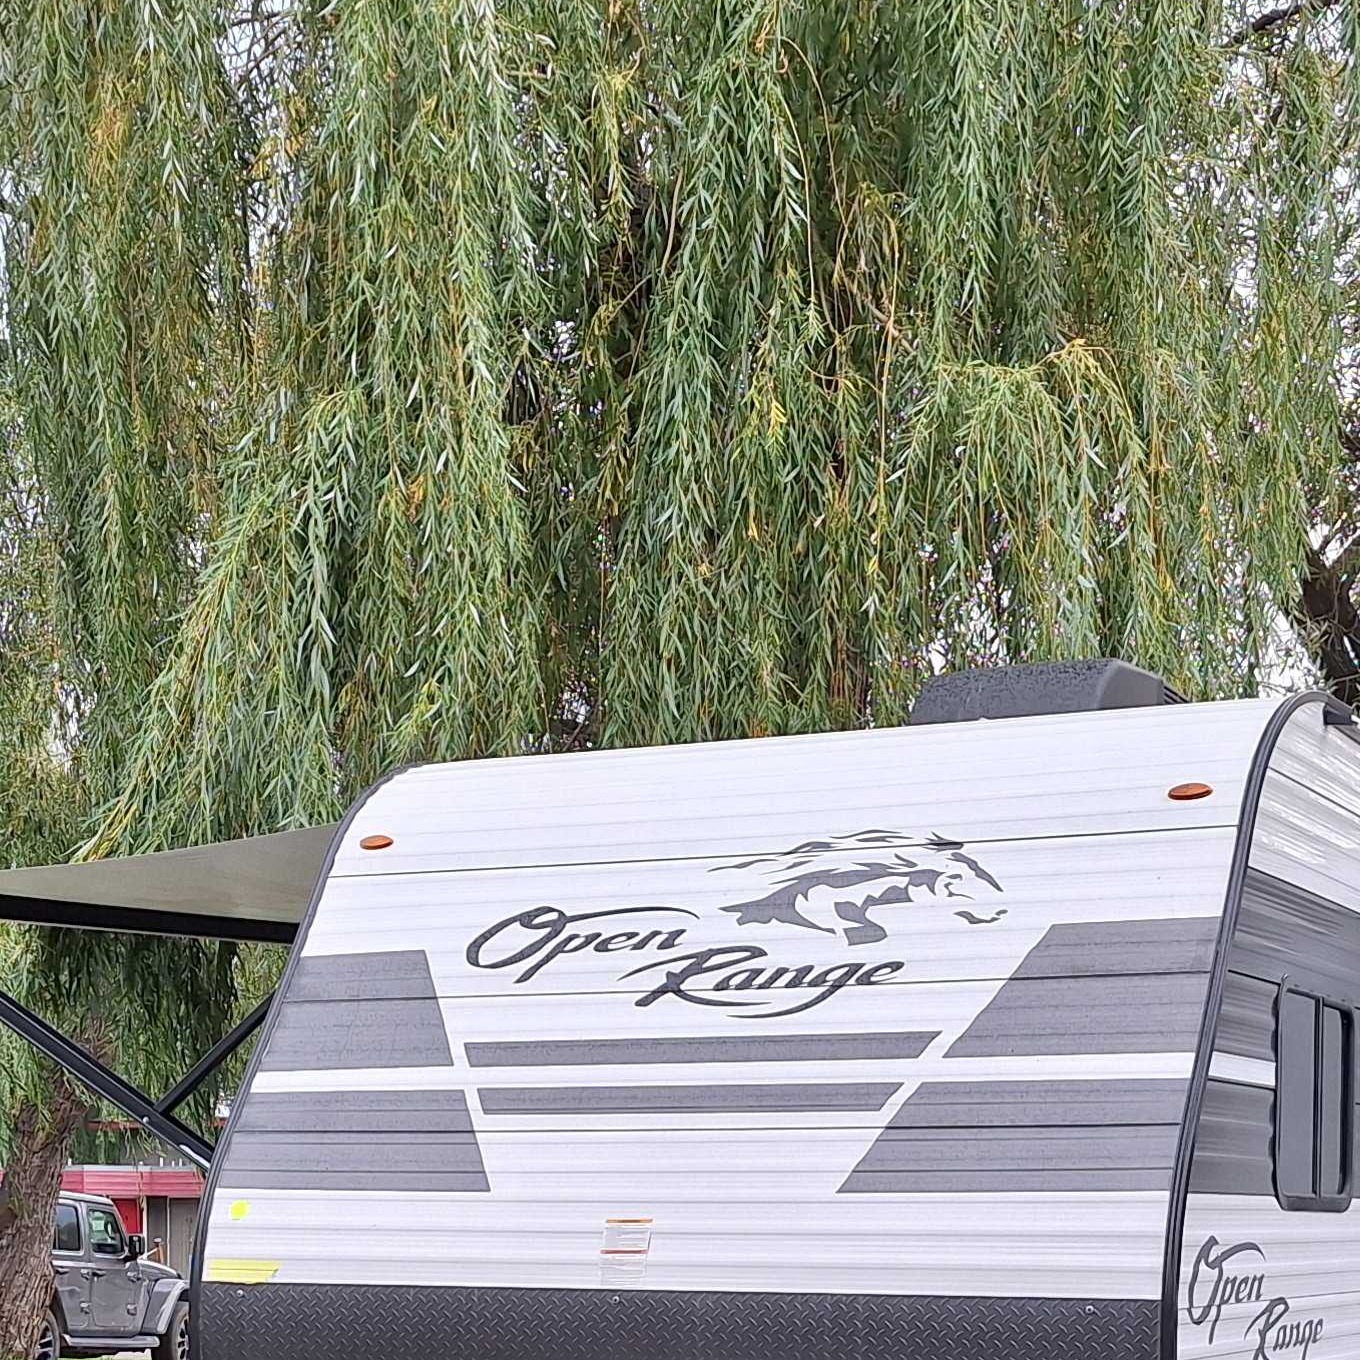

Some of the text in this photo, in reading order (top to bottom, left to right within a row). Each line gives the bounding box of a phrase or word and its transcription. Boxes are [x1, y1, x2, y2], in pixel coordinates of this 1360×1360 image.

[466, 906, 700, 984] Open
[617, 945, 905, 1019] Range
[1187, 1235, 1266, 1345] Open
